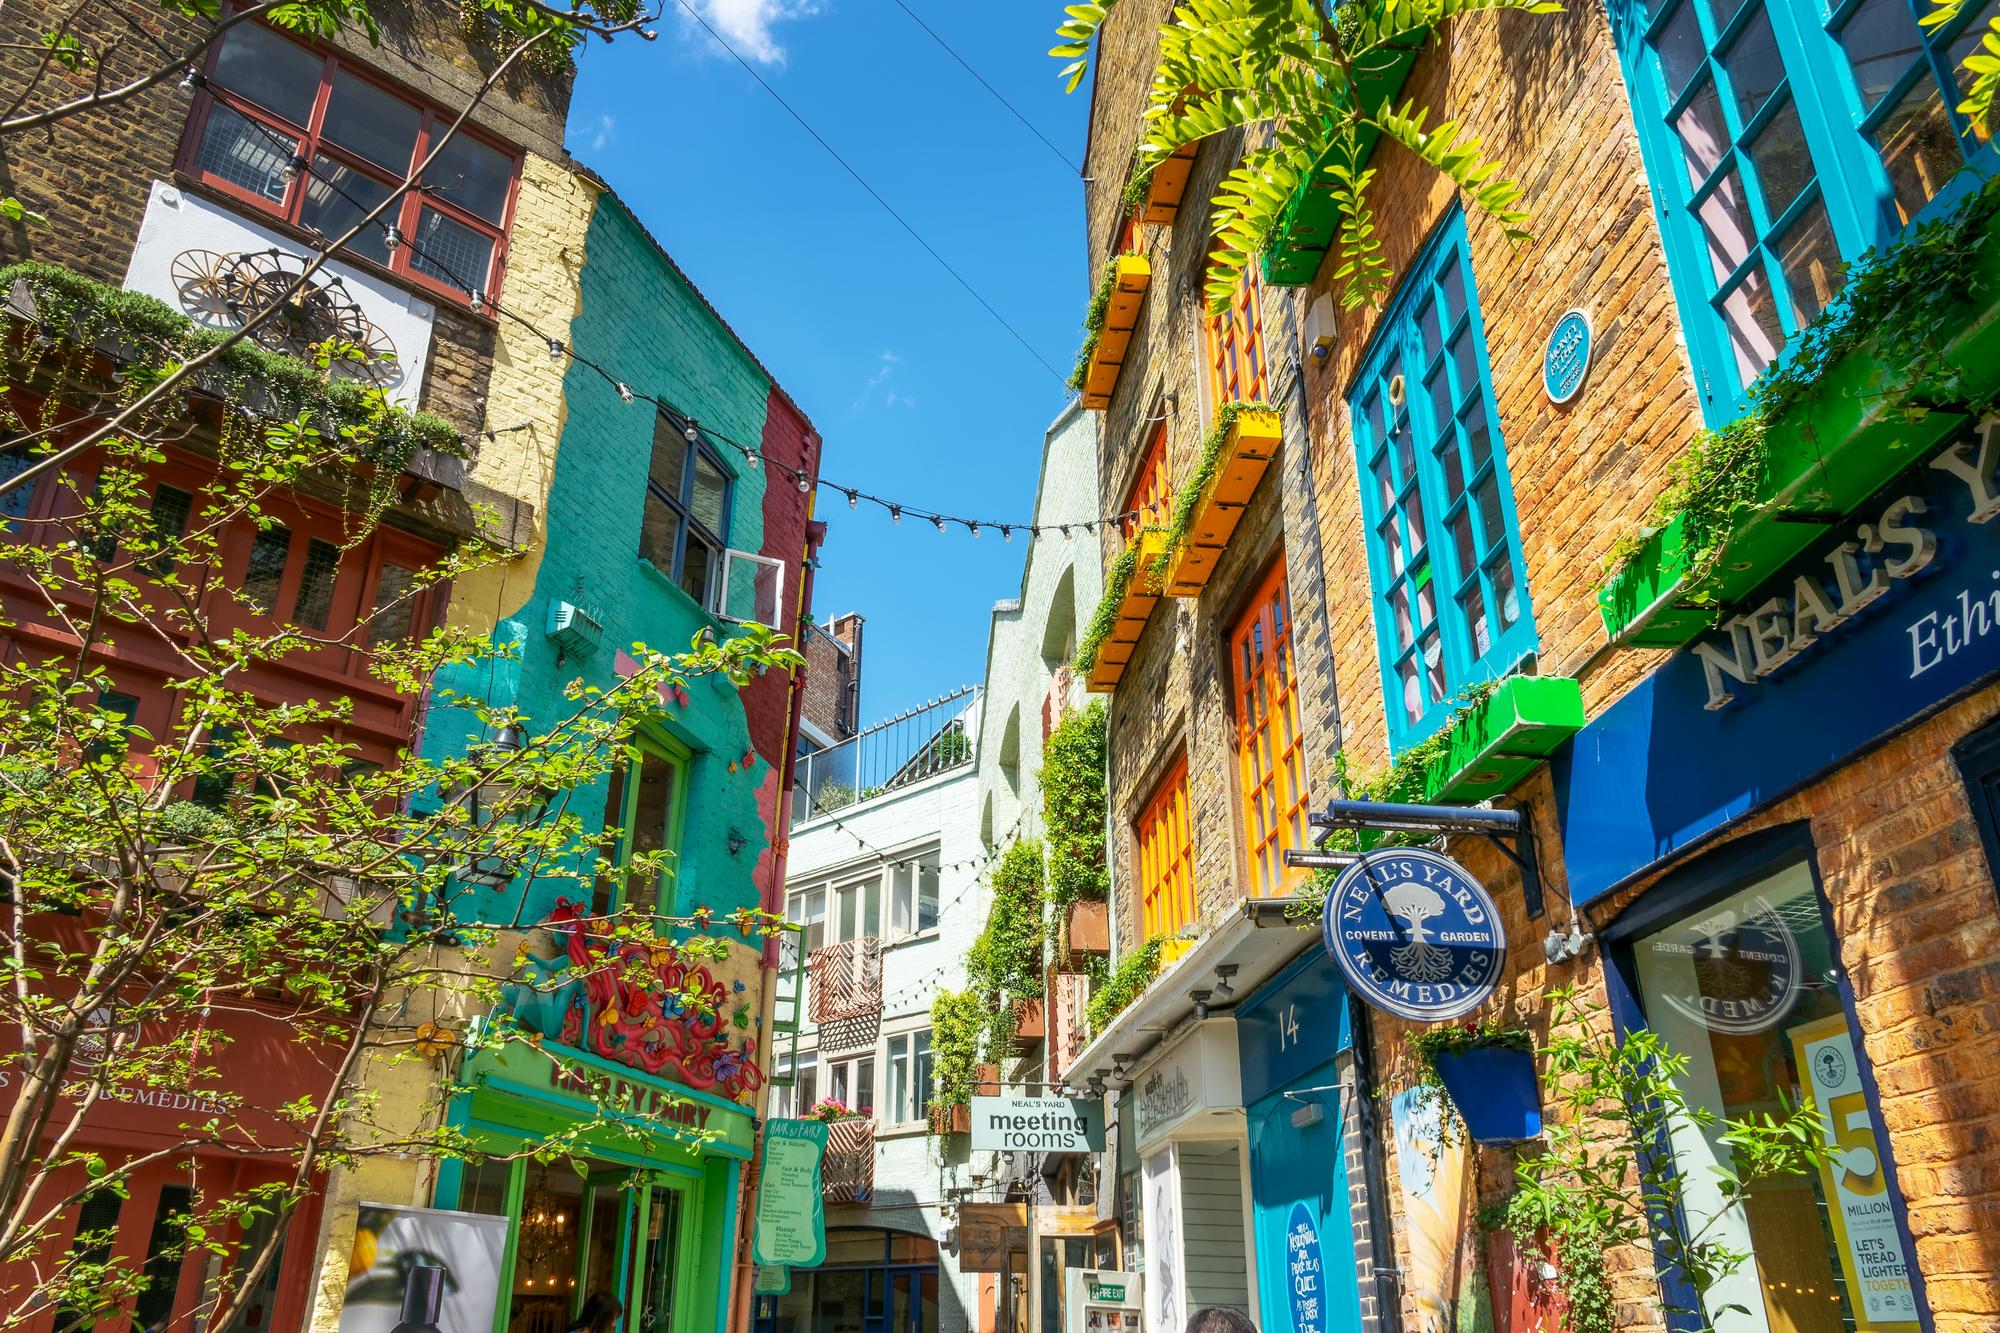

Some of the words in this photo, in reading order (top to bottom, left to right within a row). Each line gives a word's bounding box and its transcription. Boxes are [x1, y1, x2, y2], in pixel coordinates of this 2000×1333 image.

[1691, 496, 1937, 711] NEAL'S
[1344, 862, 1413, 924] NEAL'S
[1424, 865, 1485, 925] YARD
[1346, 930, 1394, 941] COVENT
[1440, 931, 1490, 942] GARDEN
[1354, 948, 1489, 1004] REMEDIES
[1279, 1003, 1300, 1053] 14
[651, 1091, 712, 1131] FAIRY
[1011, 1100, 1041, 1108] NEAL'S
[1043, 1100, 1065, 1108] YARD
[769, 1120, 788, 1136] HAIR
[798, 1123, 823, 1139] FAIRY
[989, 1112, 1088, 1136] meeting
[1004, 1132, 1075, 1148] rooms
[1828, 1091, 1886, 1196] 5
[1847, 1201, 1891, 1216] MILLION
[1856, 1238, 1885, 1251] LET'S
[1859, 1251, 1896, 1265] TREAD
[1099, 1287, 1112, 1298] FIRE
[1112, 1288, 1125, 1299] EXIT
